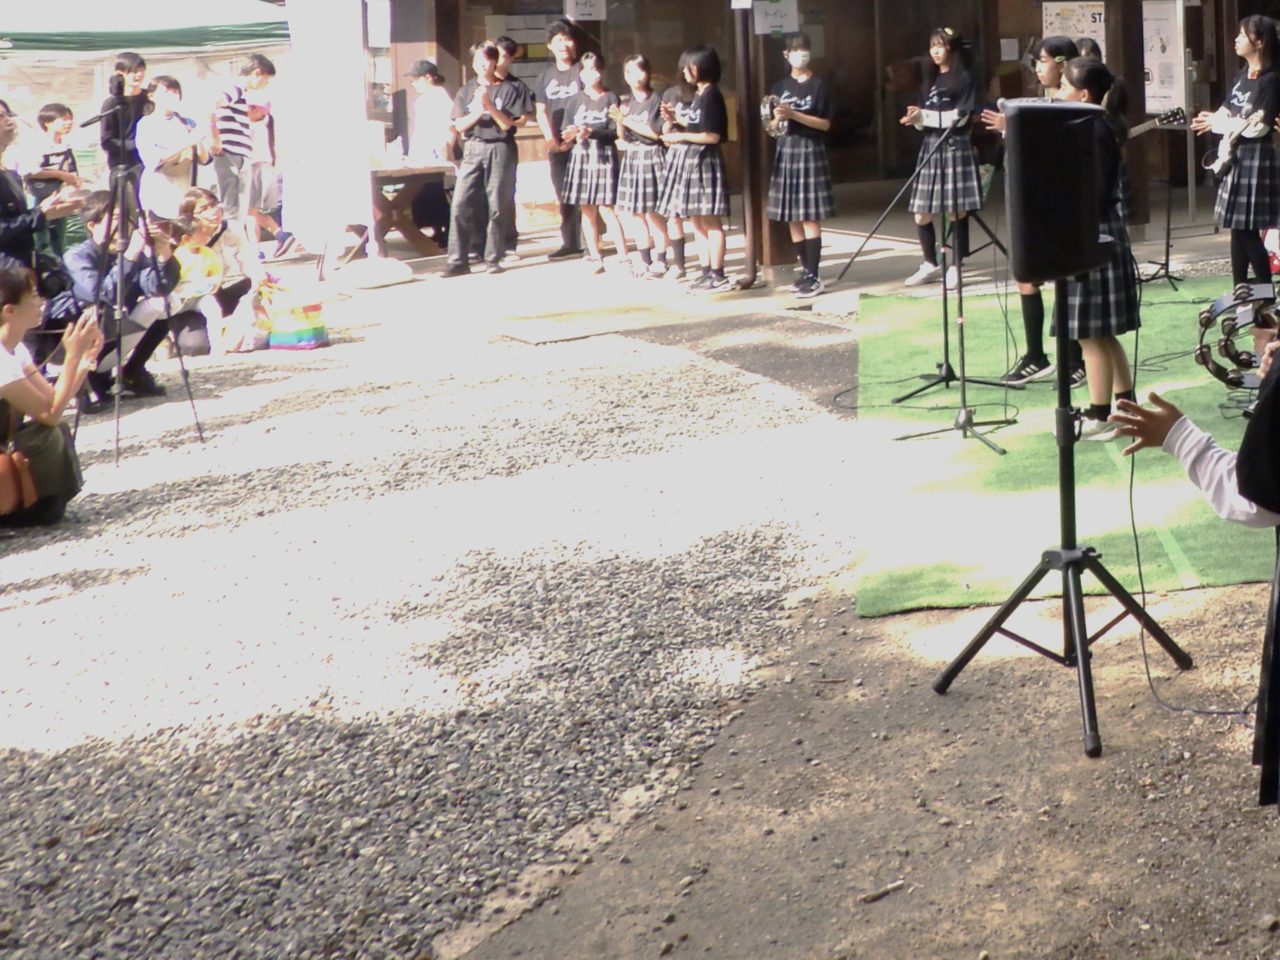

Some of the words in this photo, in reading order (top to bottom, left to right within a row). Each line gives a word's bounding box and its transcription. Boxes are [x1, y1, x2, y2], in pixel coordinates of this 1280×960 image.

[575, 0, 597, 8] トイレ
[764, 9, 788, 20] トイレ
[1090, 12, 1106, 24] ST
